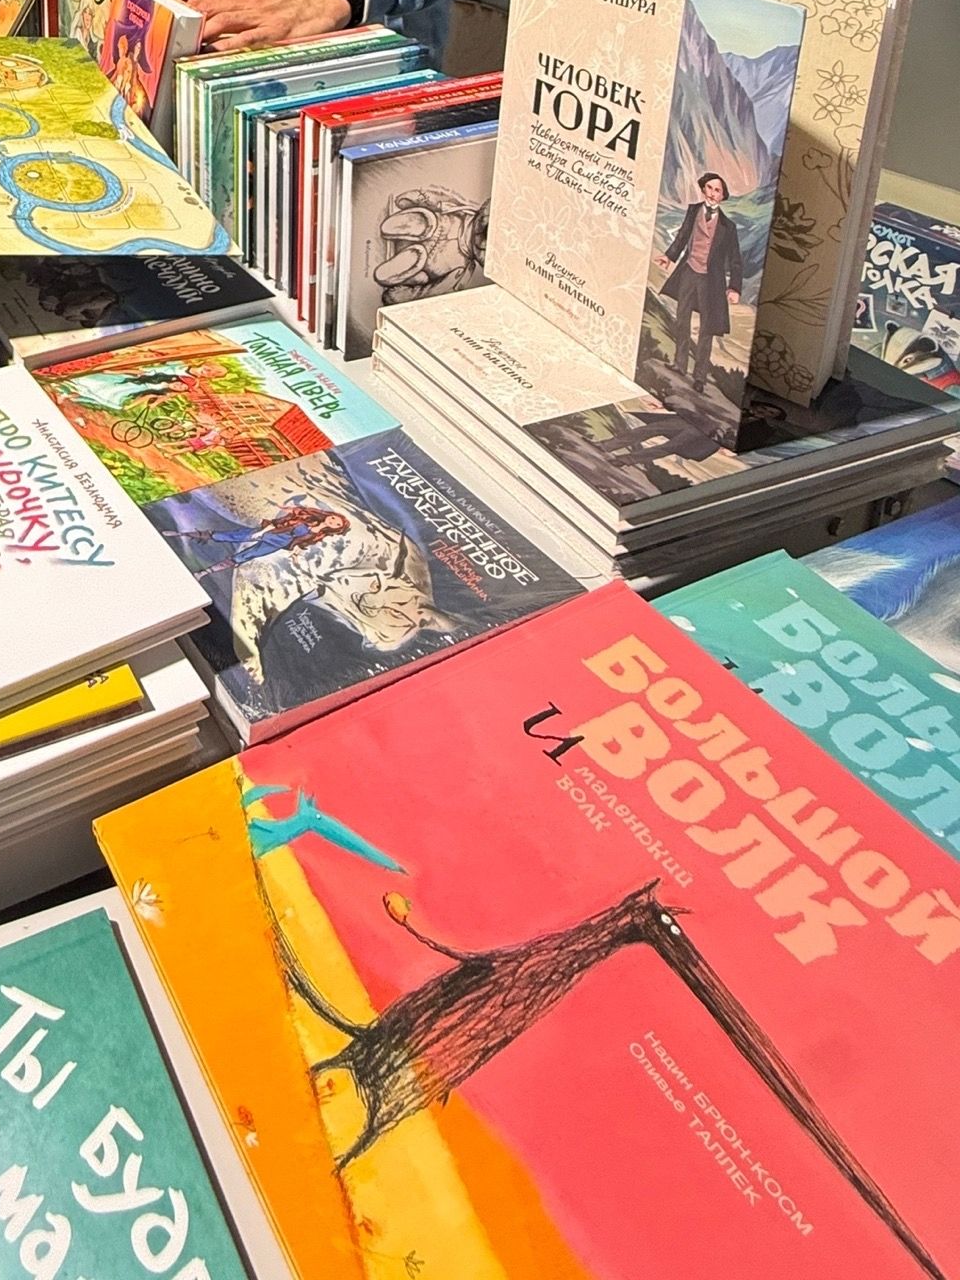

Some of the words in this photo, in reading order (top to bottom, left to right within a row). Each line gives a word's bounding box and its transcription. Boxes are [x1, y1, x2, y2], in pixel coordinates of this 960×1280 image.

[532, 78, 641, 161] ГОРА
[538, 51, 646, 115] ЧЕЛОВЕК-
[528, 158, 542, 172] на
[529, 138, 568, 168] Петра
[571, 159, 632, 202] Семёнова
[530, 120, 615, 166] Невероятный
[603, 161, 635, 187] путь
[525, 257, 555, 284] ЮЛИИ
[558, 280, 606, 317] БИЛЕНКО
[544, 251, 587, 289] Рисунки
[282, 380, 346, 419] ДВЕРЬ
[17, 454, 115, 567] КИТЕССУ
[32, 418, 77, 471] АНАСТАСИЯ
[73, 472, 123, 530] БЕЗЛЮДНАЯ
[366, 458, 506, 580] НАСЛЕДСТВО
[382, 447, 540, 586] ТАИНСТВЕННОЕ
[752, 599, 960, 772] БОЛЬ
[581, 634, 960, 965] БОЛЬШОЙ
[748, 659, 960, 852] ВОЛ
[569, 700, 870, 965] ВОЛК
[574, 766, 695, 889] маленький
[629, 1041, 686, 1114] Оливье
[688, 1114, 763, 1207] ТАЛЛЕК
[643, 1030, 694, 1091] Надин
[693, 1091, 815, 1237] БРЮН-КОСМ
